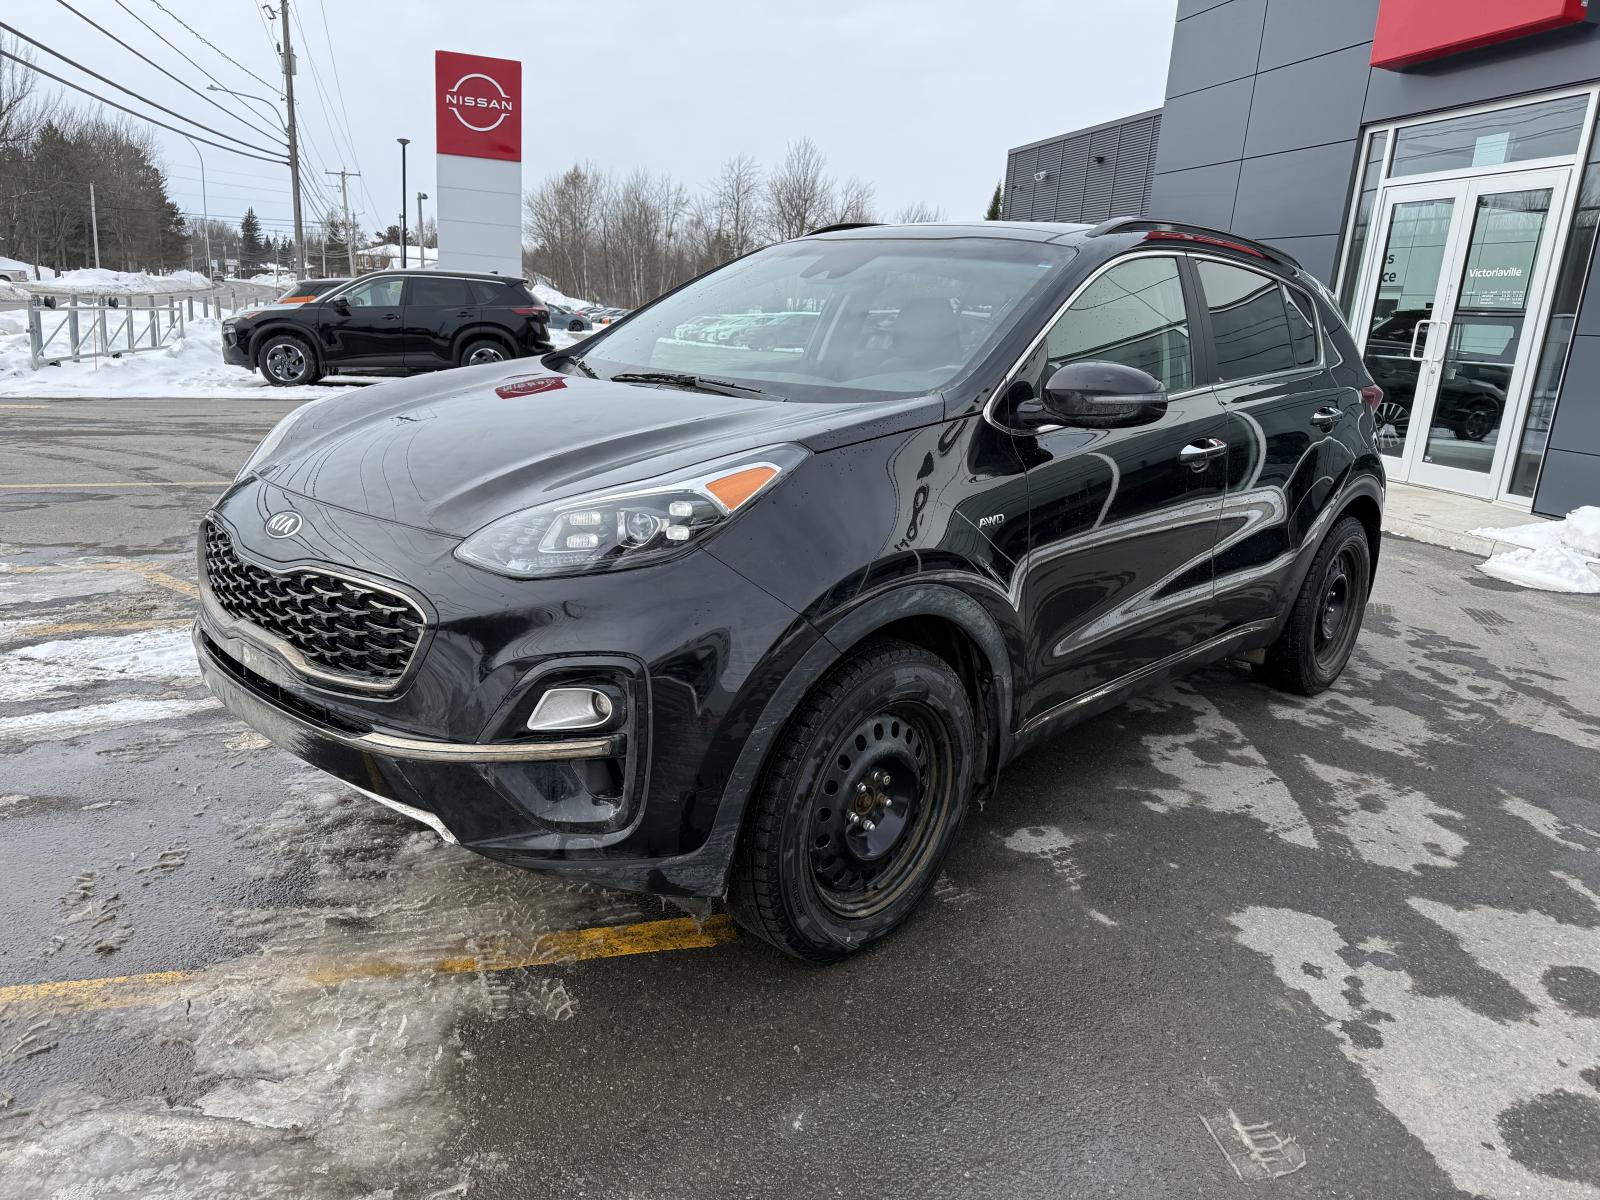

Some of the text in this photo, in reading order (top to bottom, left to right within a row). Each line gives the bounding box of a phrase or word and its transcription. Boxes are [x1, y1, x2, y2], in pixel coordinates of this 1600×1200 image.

[446, 94, 512, 111] NISSAN
[1470, 267, 1522, 277] Victoriaville
[269, 514, 295, 533] KIA
[979, 513, 1005, 528] AWD
